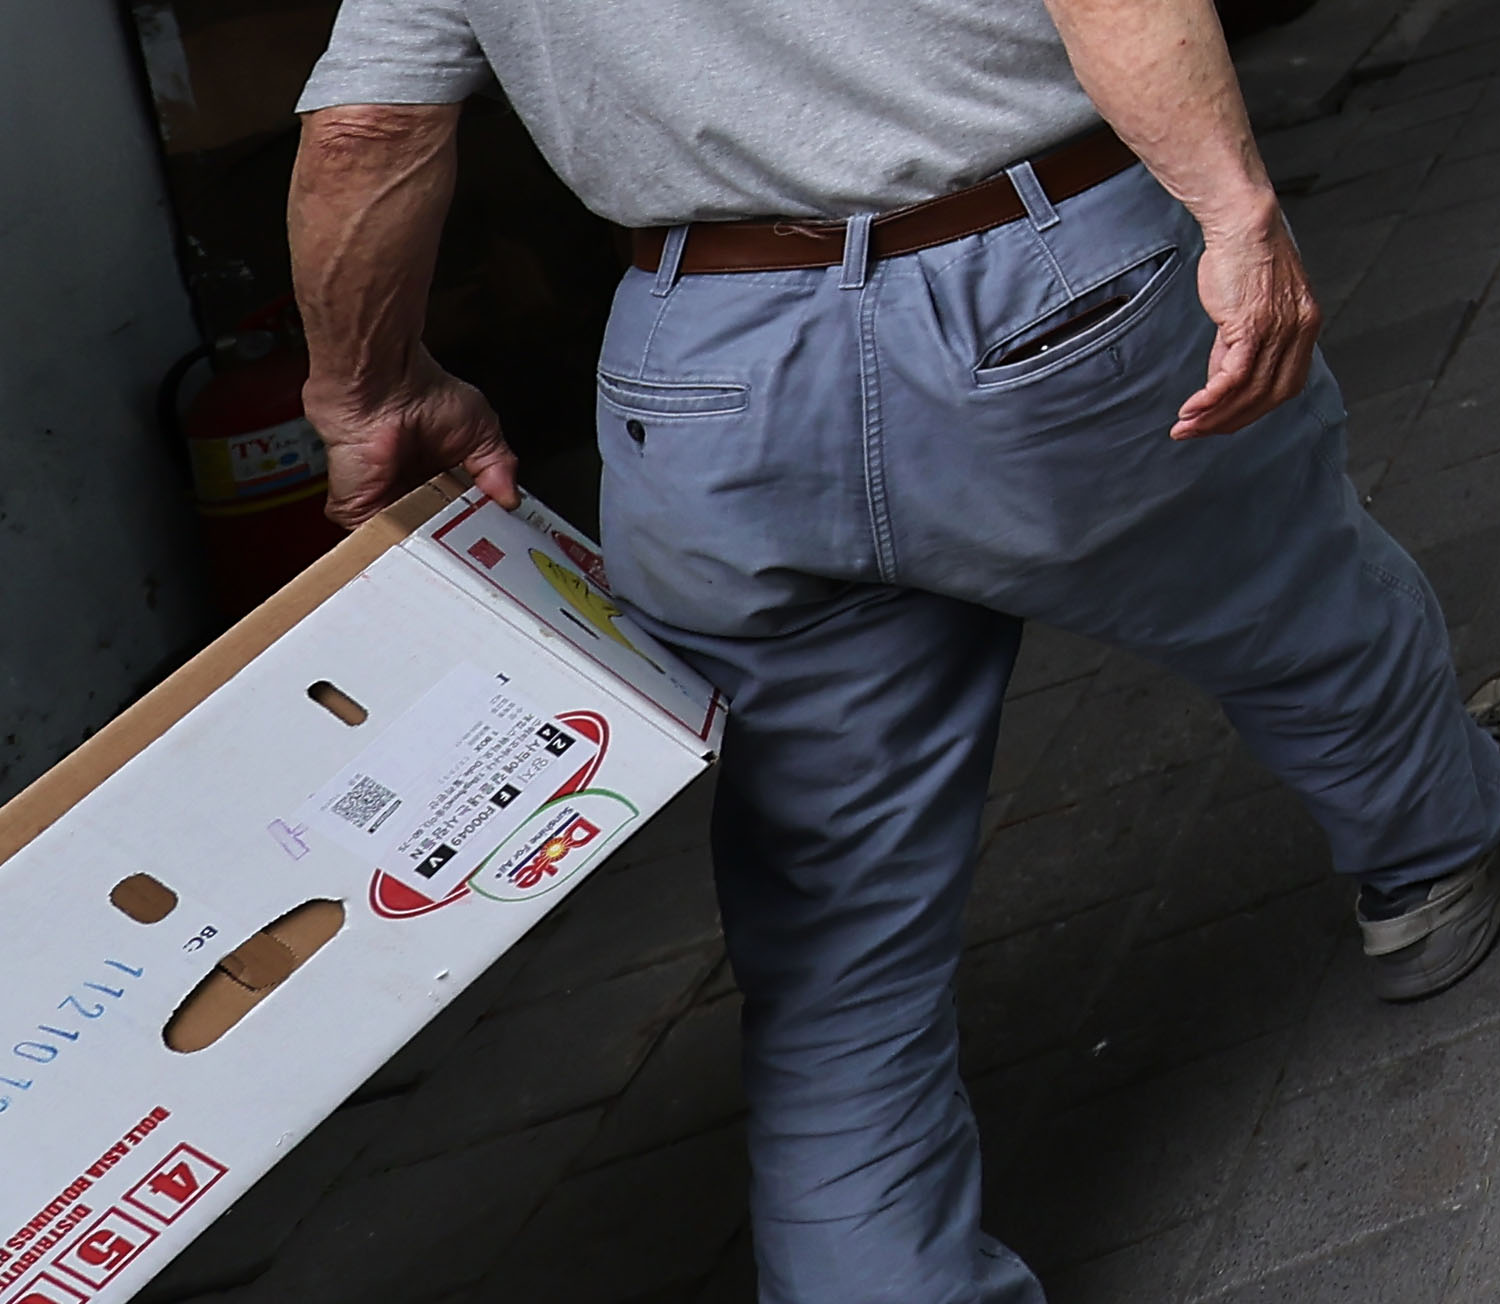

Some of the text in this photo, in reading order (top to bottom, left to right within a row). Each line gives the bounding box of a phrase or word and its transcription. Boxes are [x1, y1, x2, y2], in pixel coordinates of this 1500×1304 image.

[230, 432, 274, 459] TY
[541, 728, 551, 738] 4
[428, 737, 567, 869] 2 양지 F F00049 V
[528, 805, 573, 845] Sunshine
[511, 815, 601, 889] Dole
[512, 843, 531, 860] For
[183, 923, 218, 955] BC:
[123, 1106, 171, 1145] DOLE
[85, 1141, 130, 1178] ASIA
[7, 1176, 94, 1251] HOLDINGS
[76, 1161, 199, 1271] 4 5
